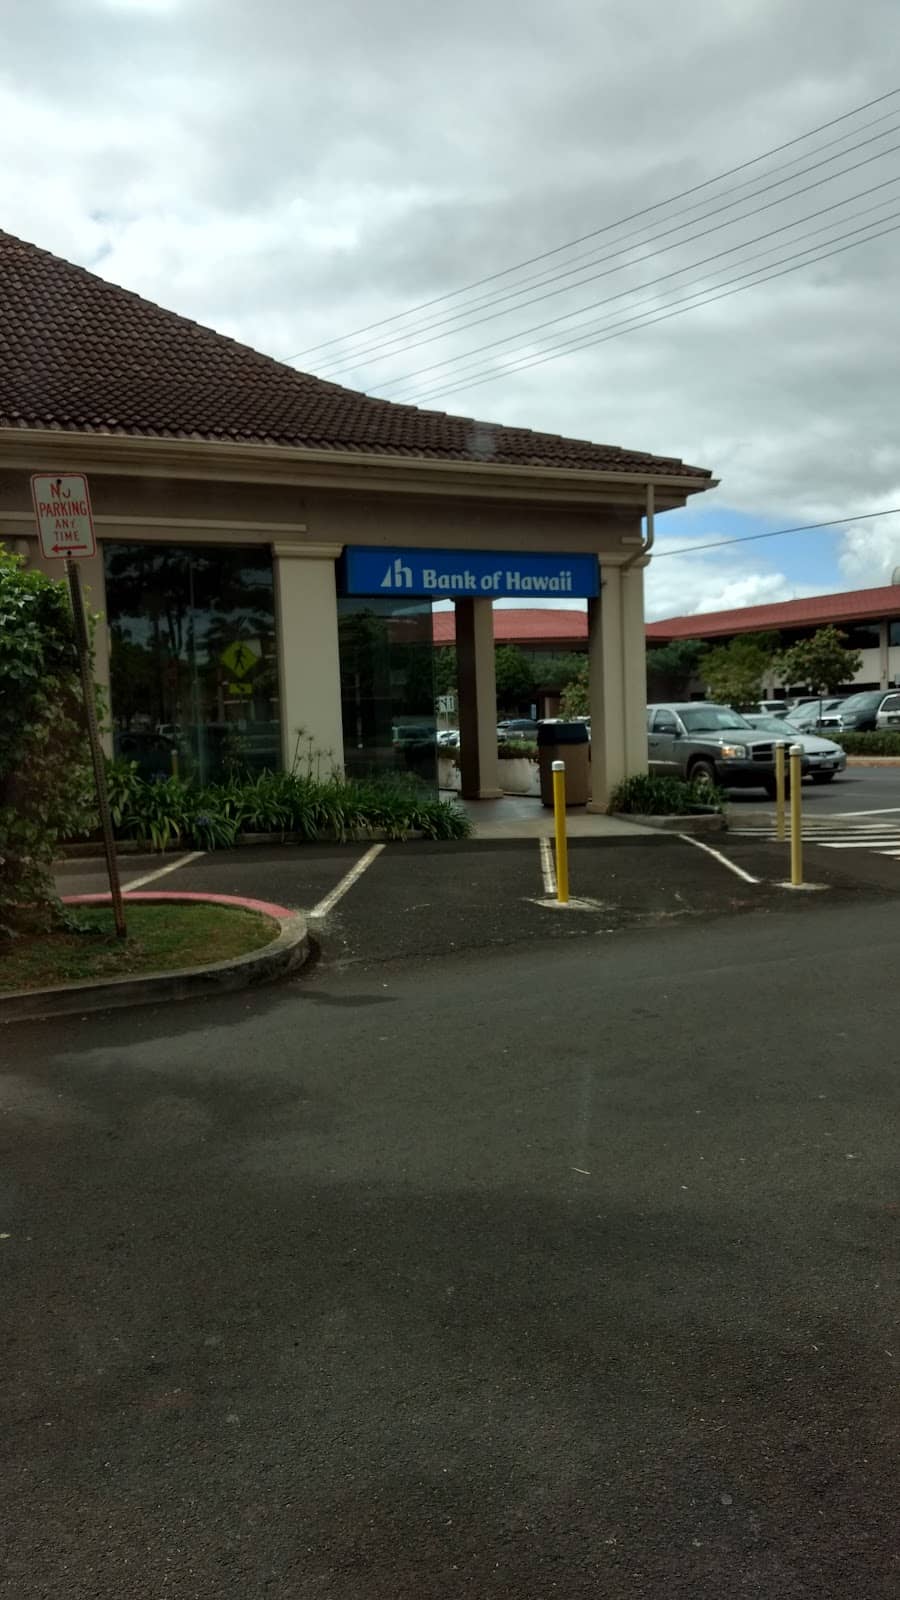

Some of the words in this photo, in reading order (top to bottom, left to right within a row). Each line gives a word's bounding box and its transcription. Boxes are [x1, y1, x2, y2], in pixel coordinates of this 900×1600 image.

[40, 501, 88, 517] PARKING
[55, 519, 76, 529] ANY
[54, 531, 79, 541] TIME
[423, 568, 477, 589] Bank
[480, 571, 502, 590] of
[506, 571, 572, 592] Hawaii
